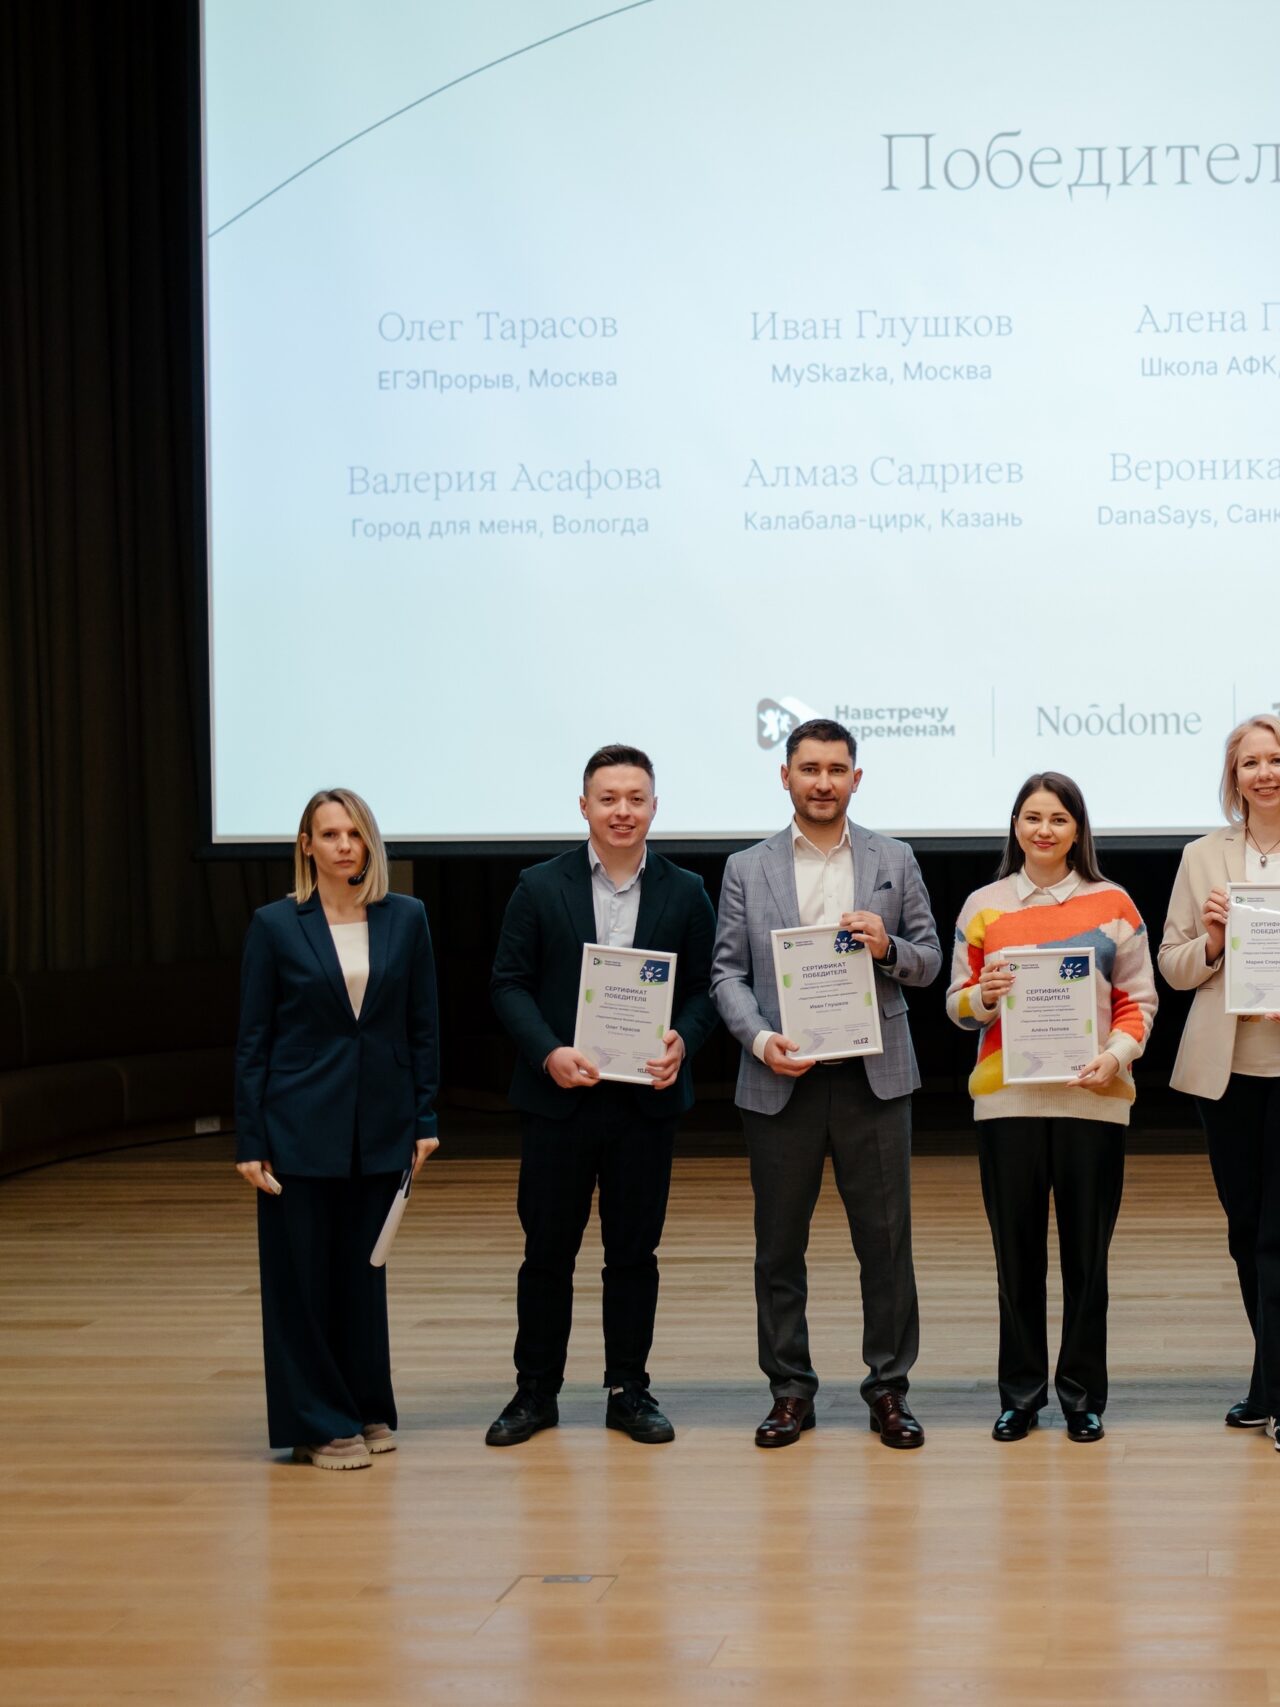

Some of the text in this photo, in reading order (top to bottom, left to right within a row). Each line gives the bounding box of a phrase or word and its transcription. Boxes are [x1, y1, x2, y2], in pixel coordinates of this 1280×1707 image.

[378, 312, 618, 348] Олег Тарасов
[751, 310, 1013, 347] Иван Глушков
[1135, 304, 1248, 333] Алена
[772, 361, 992, 388] MySkazka, Москва
[1141, 357, 1218, 376] Школа
[378, 368, 617, 394] ЕГЭПрорыв, Москва
[348, 459, 662, 501] Валерия Асафова
[743, 456, 1023, 493] Алмаз Садриев
[352, 514, 649, 542] Город для меня, Вологда
[744, 508, 1022, 533] Калабала-цирк, Казань
[1098, 505, 1218, 529] DanaSays,
[834, 704, 949, 721] Навстречу
[847, 722, 956, 740] еременам
[802, 962, 846, 971] СЕРТИФИКАТ
[802, 969, 847, 978] ПОБЕДИТЕЛЯ
[604, 992, 646, 1002] ПОБЕДИТЕЛЯ
[605, 985, 647, 995] СЕРТИФИКАТ
